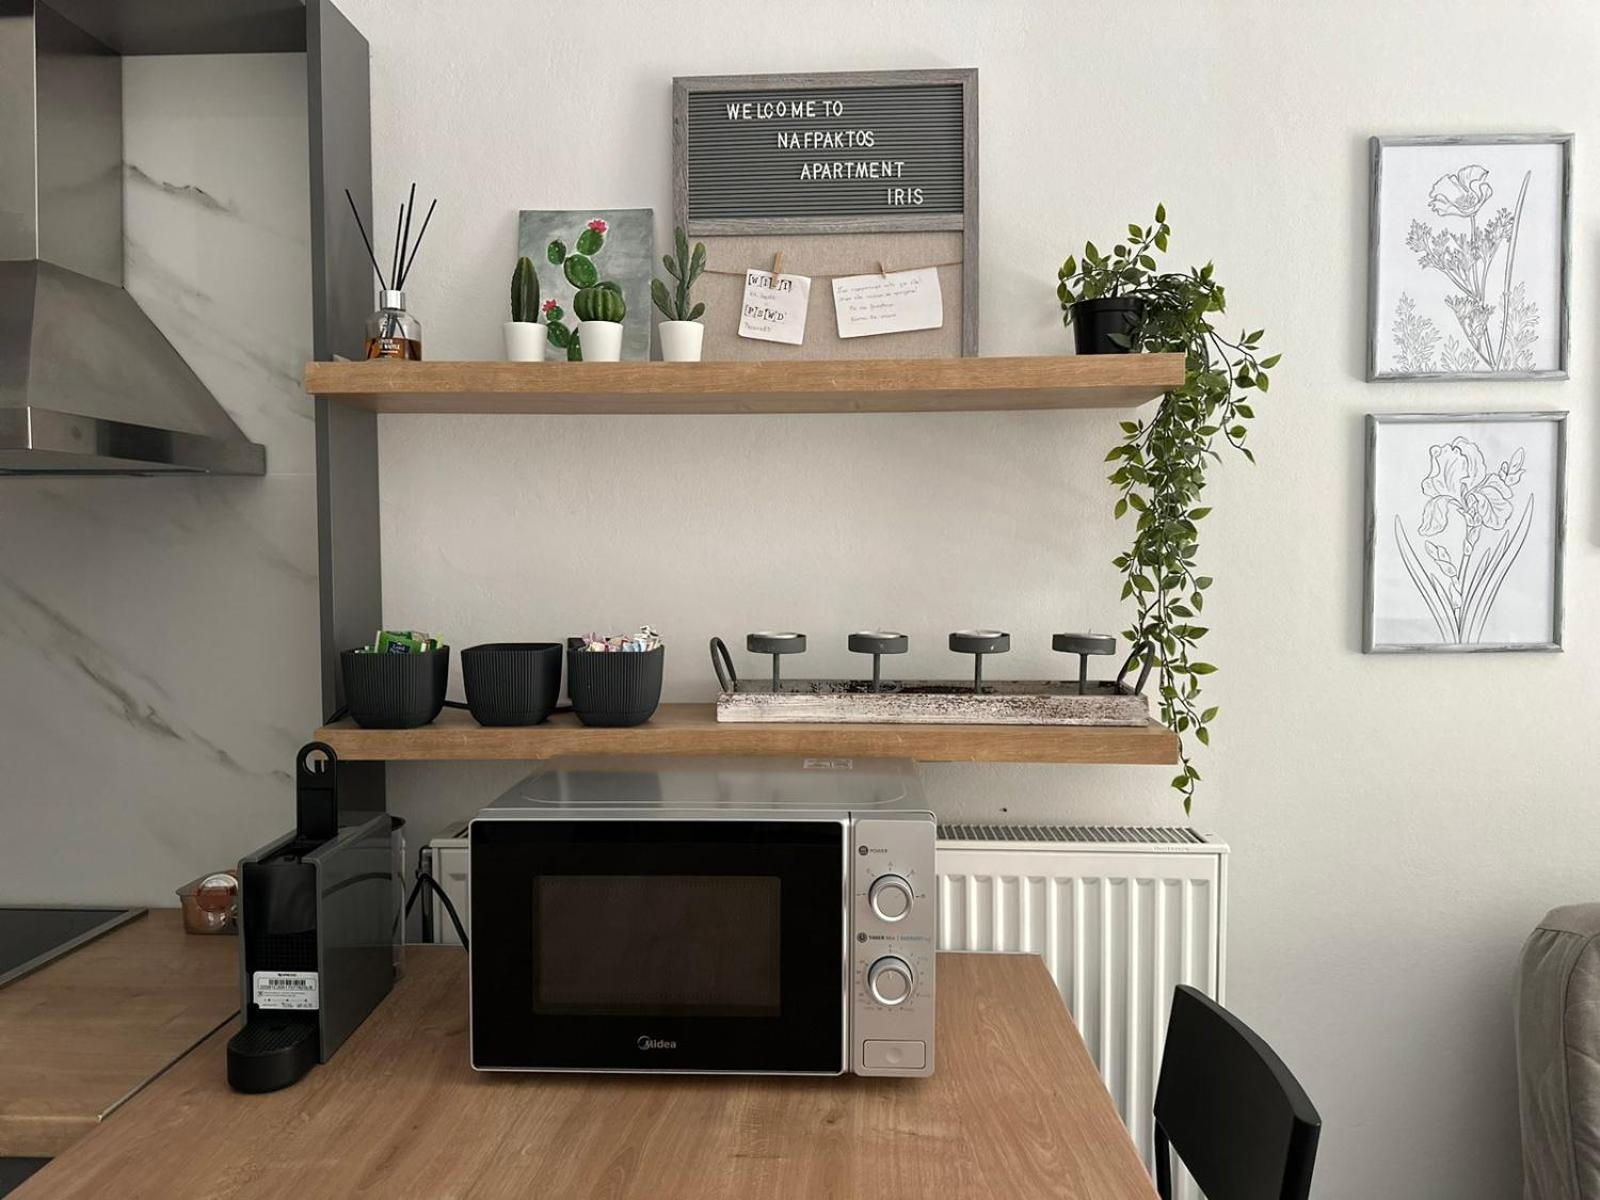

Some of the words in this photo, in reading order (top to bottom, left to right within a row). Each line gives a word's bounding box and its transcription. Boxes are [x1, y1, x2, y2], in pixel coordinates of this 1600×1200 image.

[726, 101, 816, 120] WELCOME
[823, 100, 843, 117] TO
[777, 130, 875, 150] NAFPAKTOS
[800, 161, 904, 181] APARTMENT
[887, 188, 924, 206] IRIS
[748, 273, 792, 292] WII
